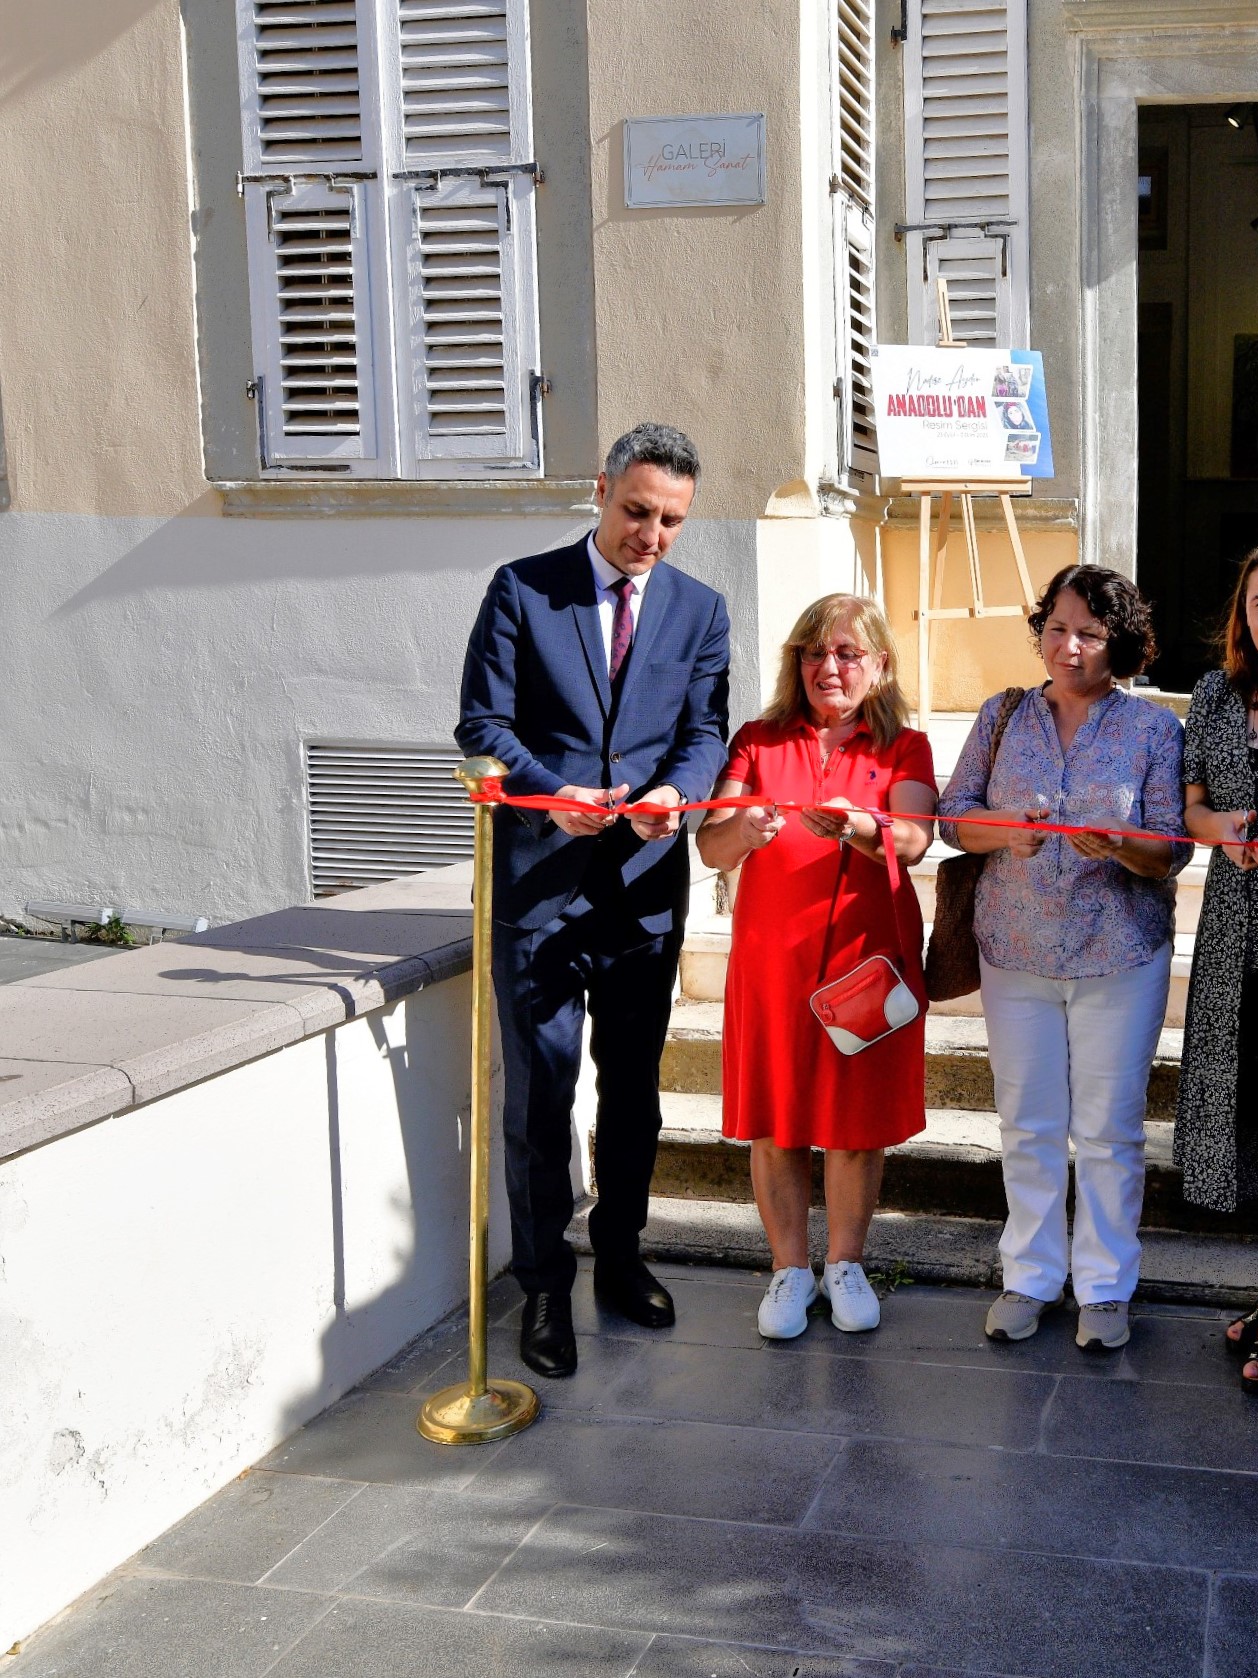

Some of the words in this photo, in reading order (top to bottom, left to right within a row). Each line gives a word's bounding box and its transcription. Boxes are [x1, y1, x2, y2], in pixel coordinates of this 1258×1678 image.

[662, 139, 726, 160] GALERİ
[637, 153, 697, 181] Hamam
[703, 150, 755, 177] Sanat
[887, 394, 987, 418] ANADOLU'DAN
[922, 420, 953, 430] Resim
[955, 420, 988, 432] Sergisi
